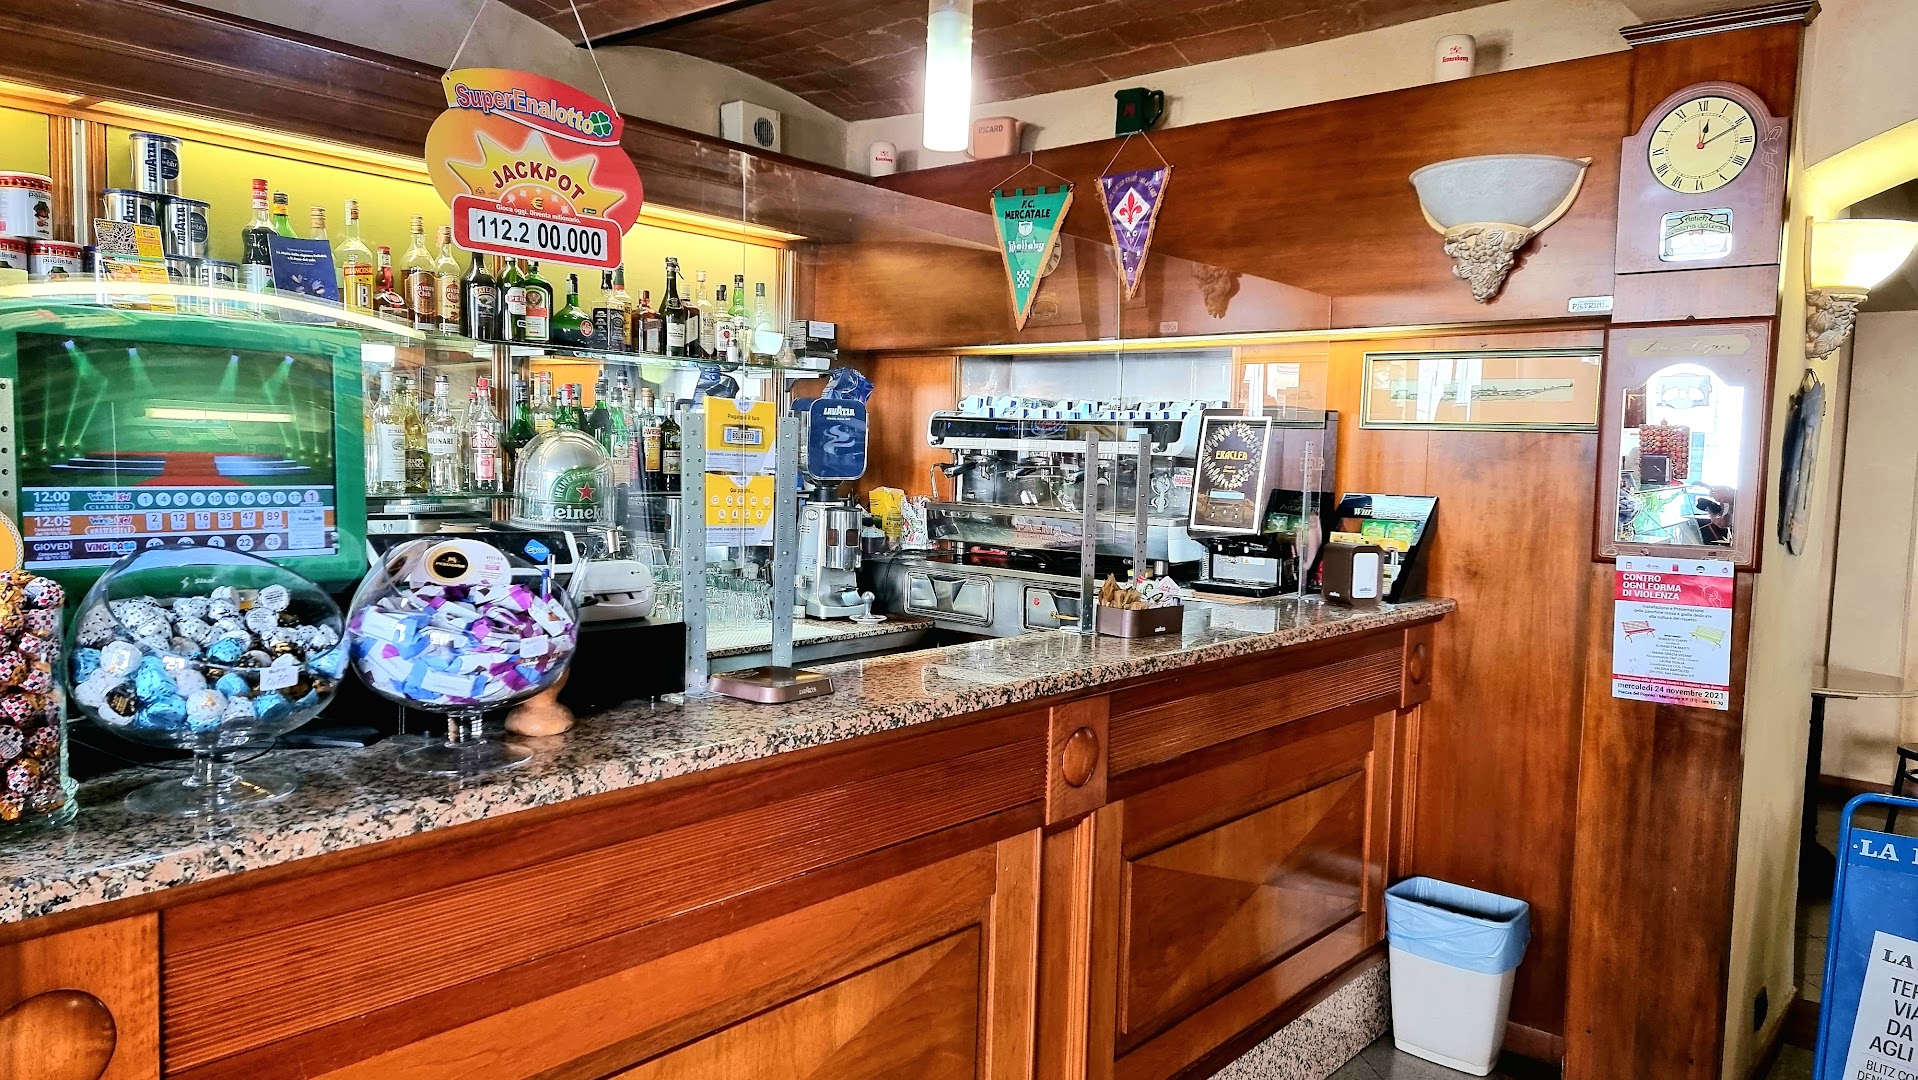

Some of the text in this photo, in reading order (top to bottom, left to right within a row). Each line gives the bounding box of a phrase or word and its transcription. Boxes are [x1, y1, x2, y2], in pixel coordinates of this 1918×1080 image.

[455, 84, 594, 136] SuperEnalotto
[492, 161, 586, 202] JACKPOT
[1022, 200, 1035, 208] F.C.
[496, 204, 513, 212] Gioca
[530, 210, 551, 218] Diventa
[552, 215, 581, 223] milionario.
[1005, 209, 1050, 219] MERCATALE
[477, 216, 601, 256] 112.2 00.000
[1008, 239, 1044, 253] Wallaby
[823, 406, 855, 416] LAVAZZA
[1215, 450, 1247, 460] ERACLEA
[33, 491, 70, 502] 12:00
[34, 516, 71, 527] 12:05
[266, 512, 279, 520] 89
[33, 541, 73, 551] GIOVEDÌ
[1623, 574, 1661, 582] CONTRO
[1648, 583, 1681, 592] FORMA
[1634, 590, 1679, 600] VIOLENZA
[1666, 688, 1702, 697] novembre
[1859, 839, 1899, 861] LA
[1882, 948, 1914, 969] LA
[1886, 1019, 1913, 1041] DA
[1869, 1035, 1914, 1062] AGLI
[1866, 1059, 1896, 1078] BLITZ
